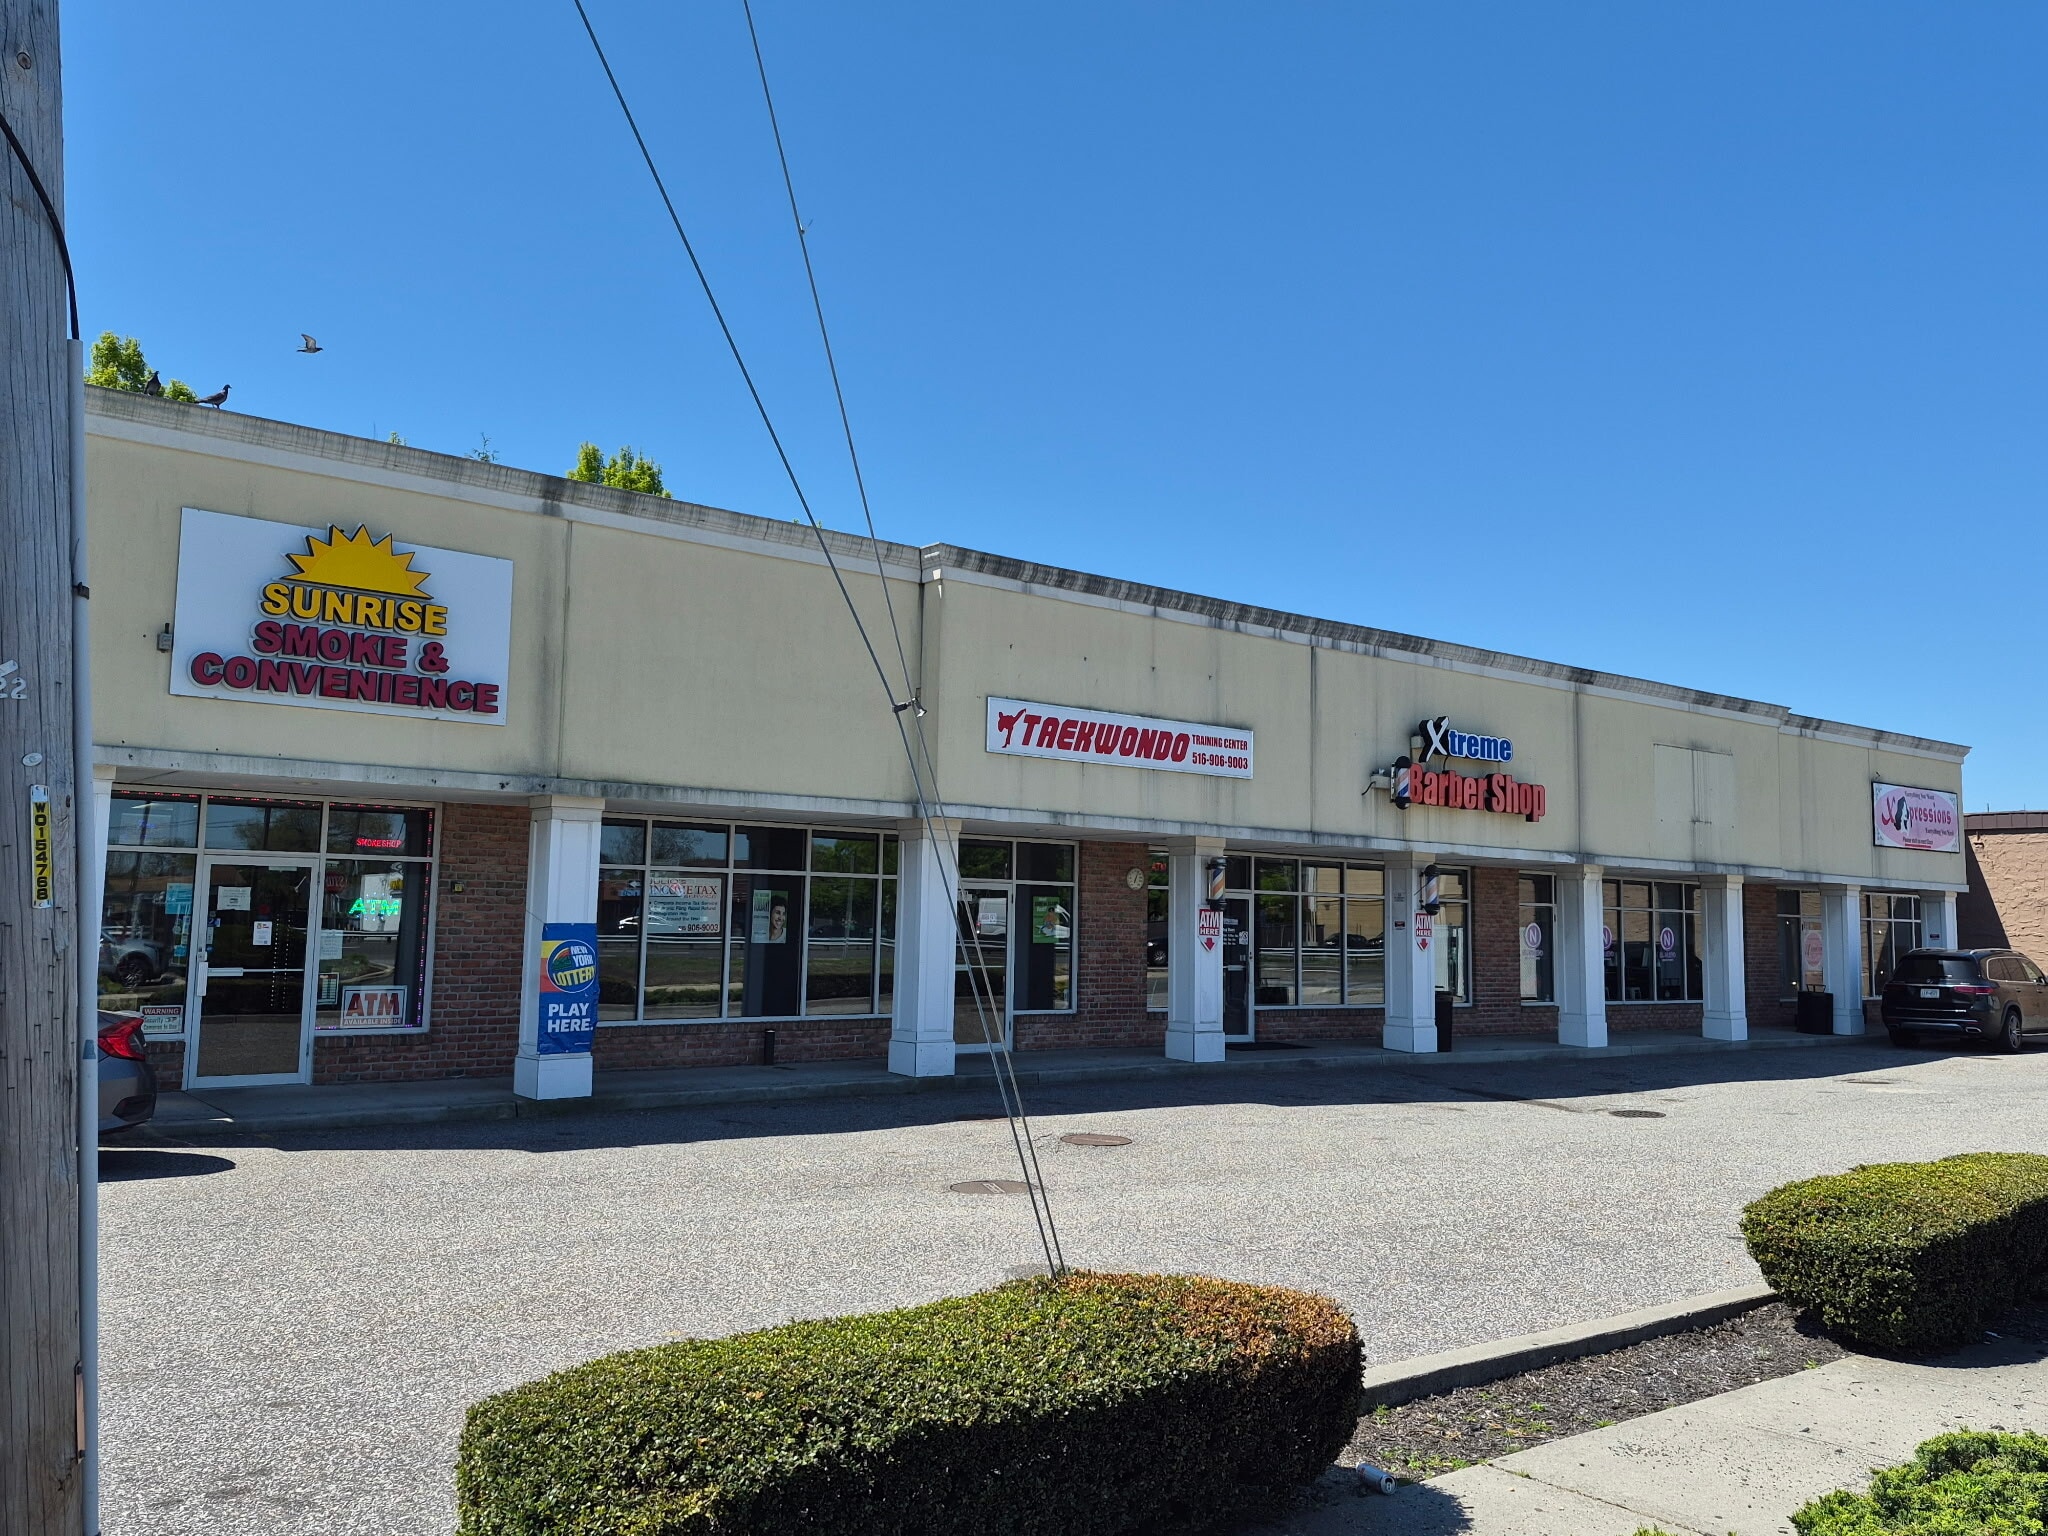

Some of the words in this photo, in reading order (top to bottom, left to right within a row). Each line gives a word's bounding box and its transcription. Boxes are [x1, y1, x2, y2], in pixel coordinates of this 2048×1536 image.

[262, 582, 448, 636] SUNRISE
[253, 620, 408, 669] SMOKE
[419, 641, 450, 674] &
[190, 652, 499, 714] CONVENIENCE
[1021, 714, 1191, 763] TAEKWONDO
[1192, 734, 1223, 748] TRAINING
[1224, 738, 1248, 750] CENTER
[1421, 716, 1513, 763] Xtreme
[1192, 752, 1248, 770] 516-906-9003
[1409, 762, 1487, 811] Barber
[1489, 773, 1546, 822] Shop
[694, 886, 718, 895] TAX
[348, 897, 400, 916] ATM
[687, 923, 719, 932] 906-9003
[1200, 910, 1219, 928] ATM
[1416, 914, 1431, 929] ATM
[570, 945, 588, 956] NEW
[572, 954, 594, 968] YORK
[346, 993, 400, 1017] ATM
[548, 1003, 589, 1017] PLAY
[343, 1018, 379, 1026] AVAILABLE
[380, 1018, 402, 1026] INSIDE
[547, 1018, 594, 1033] HERE.
